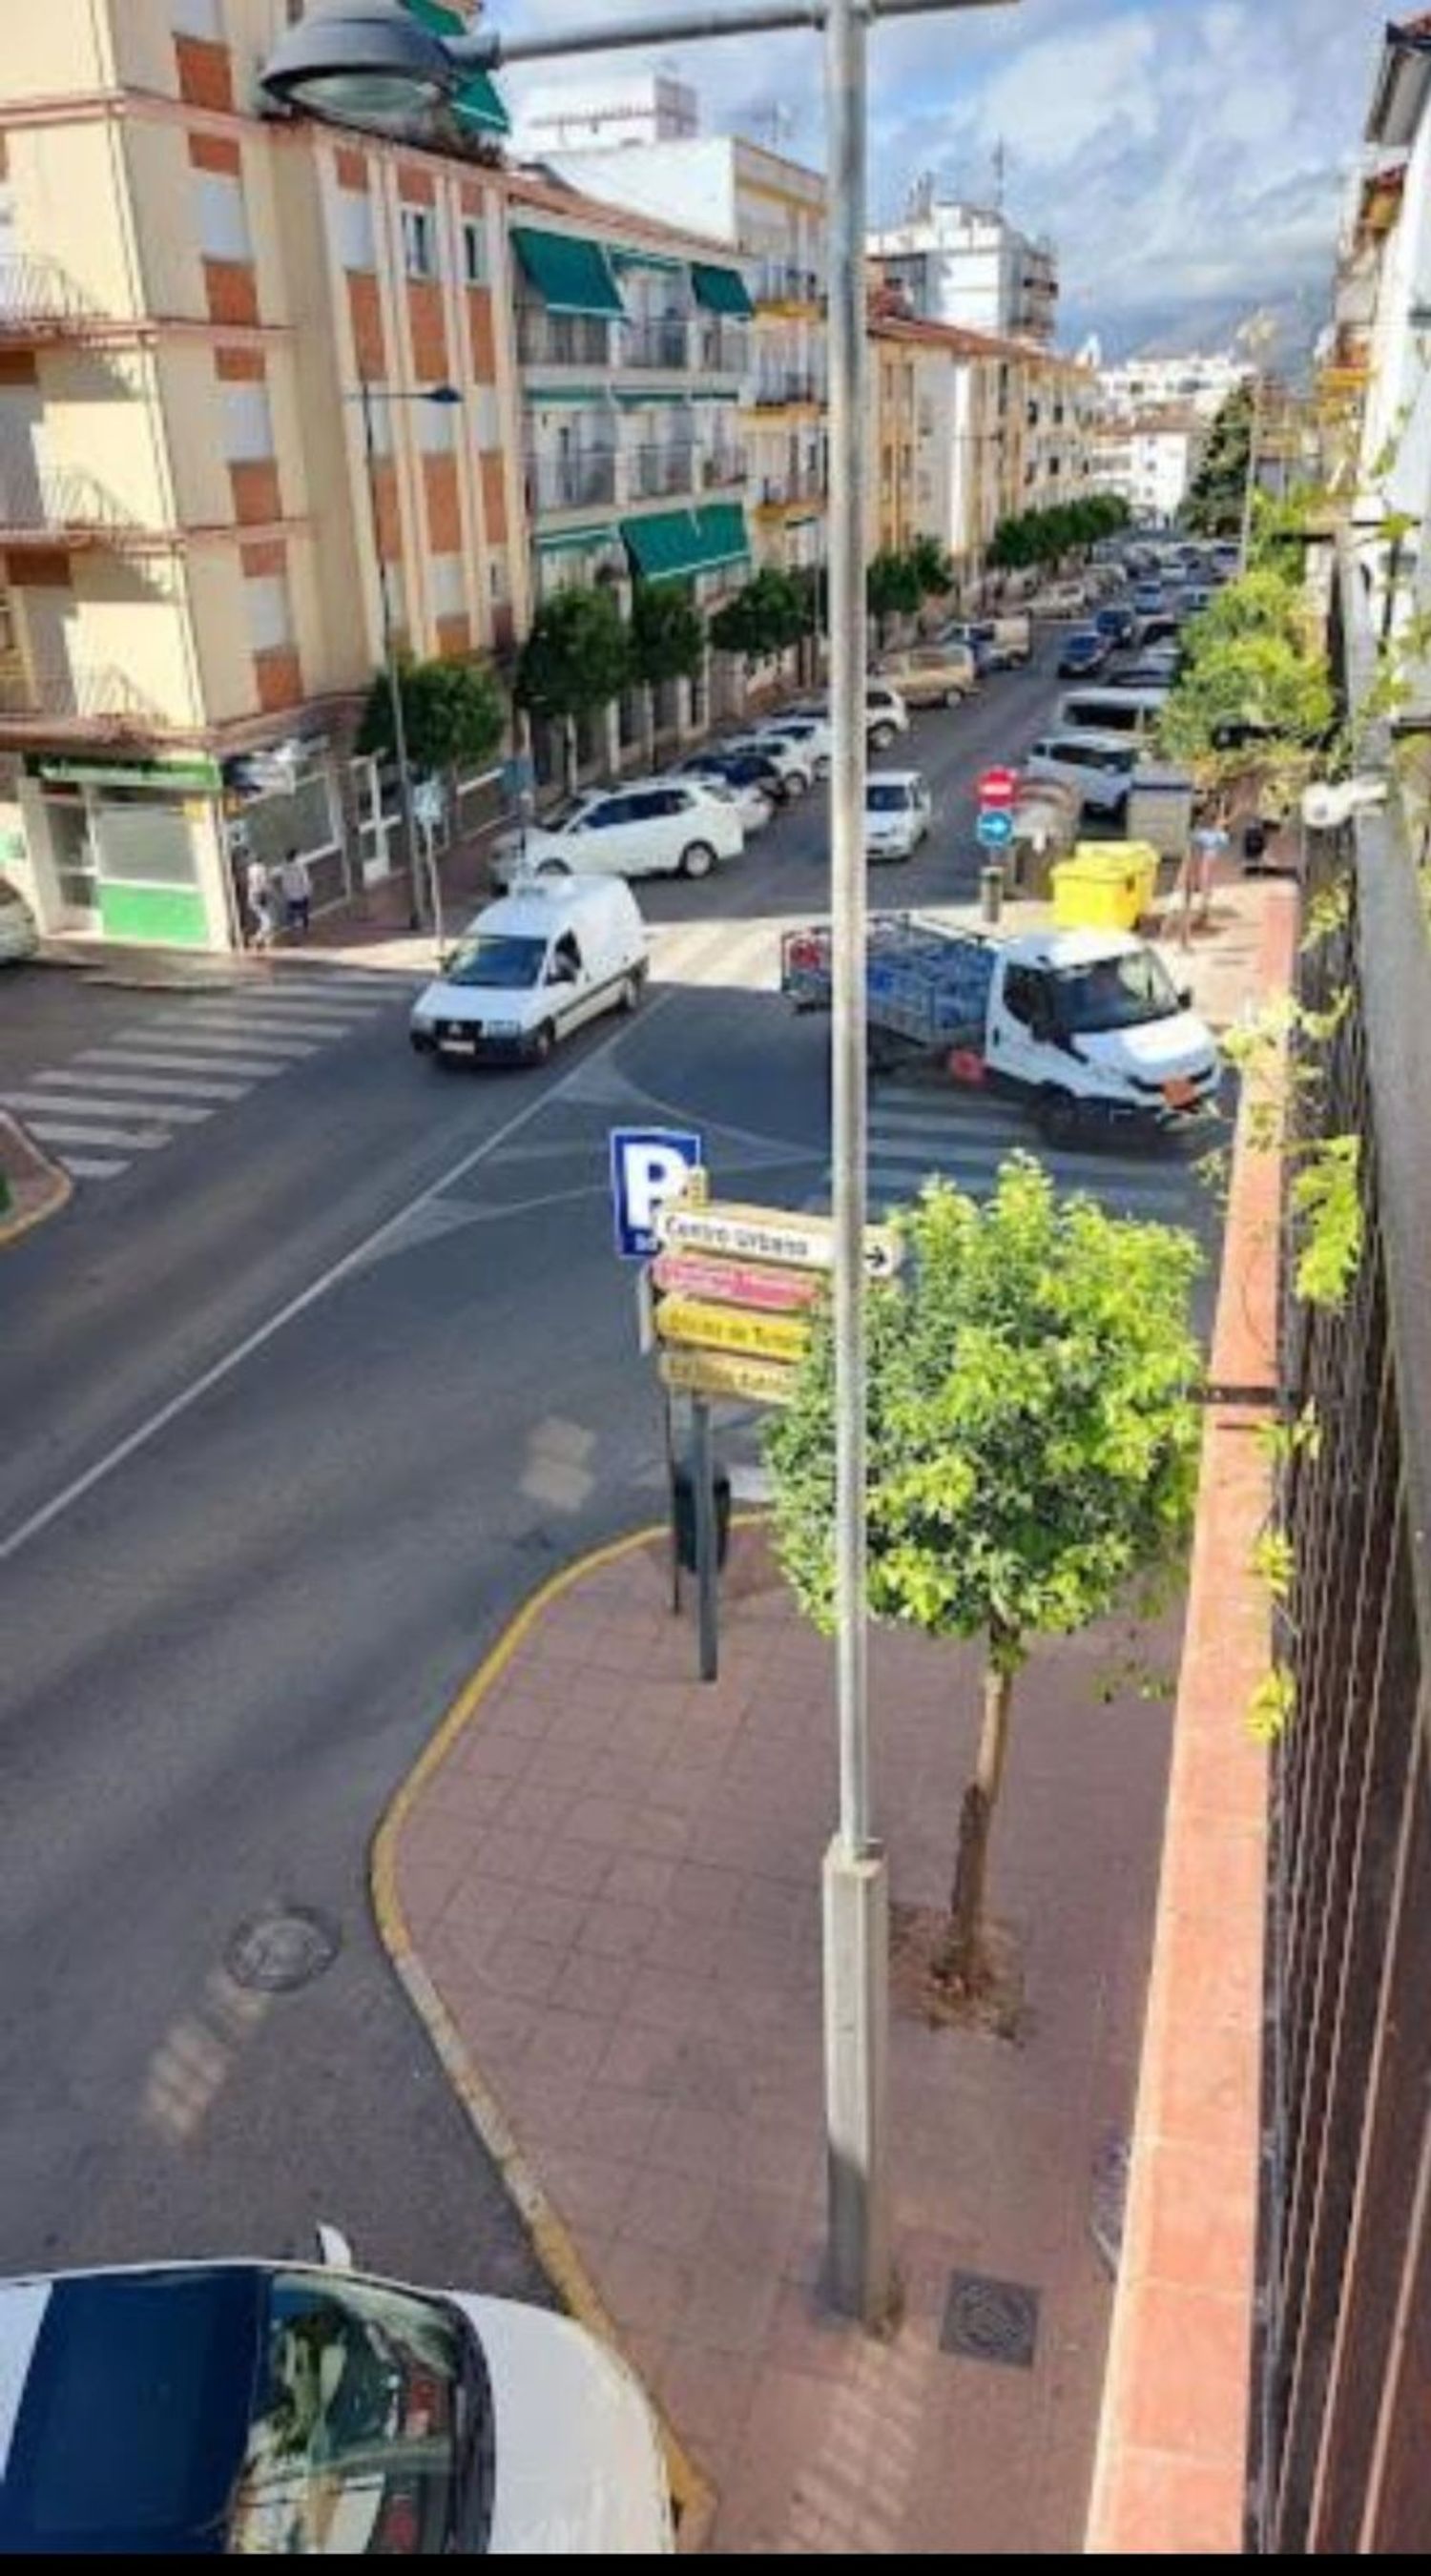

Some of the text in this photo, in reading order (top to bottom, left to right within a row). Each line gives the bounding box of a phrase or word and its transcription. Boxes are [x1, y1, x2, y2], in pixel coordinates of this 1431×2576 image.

[623, 1143, 686, 1227] P
[665, 1214, 730, 1244] Centro
[734, 1227, 809, 1257] Urbano
